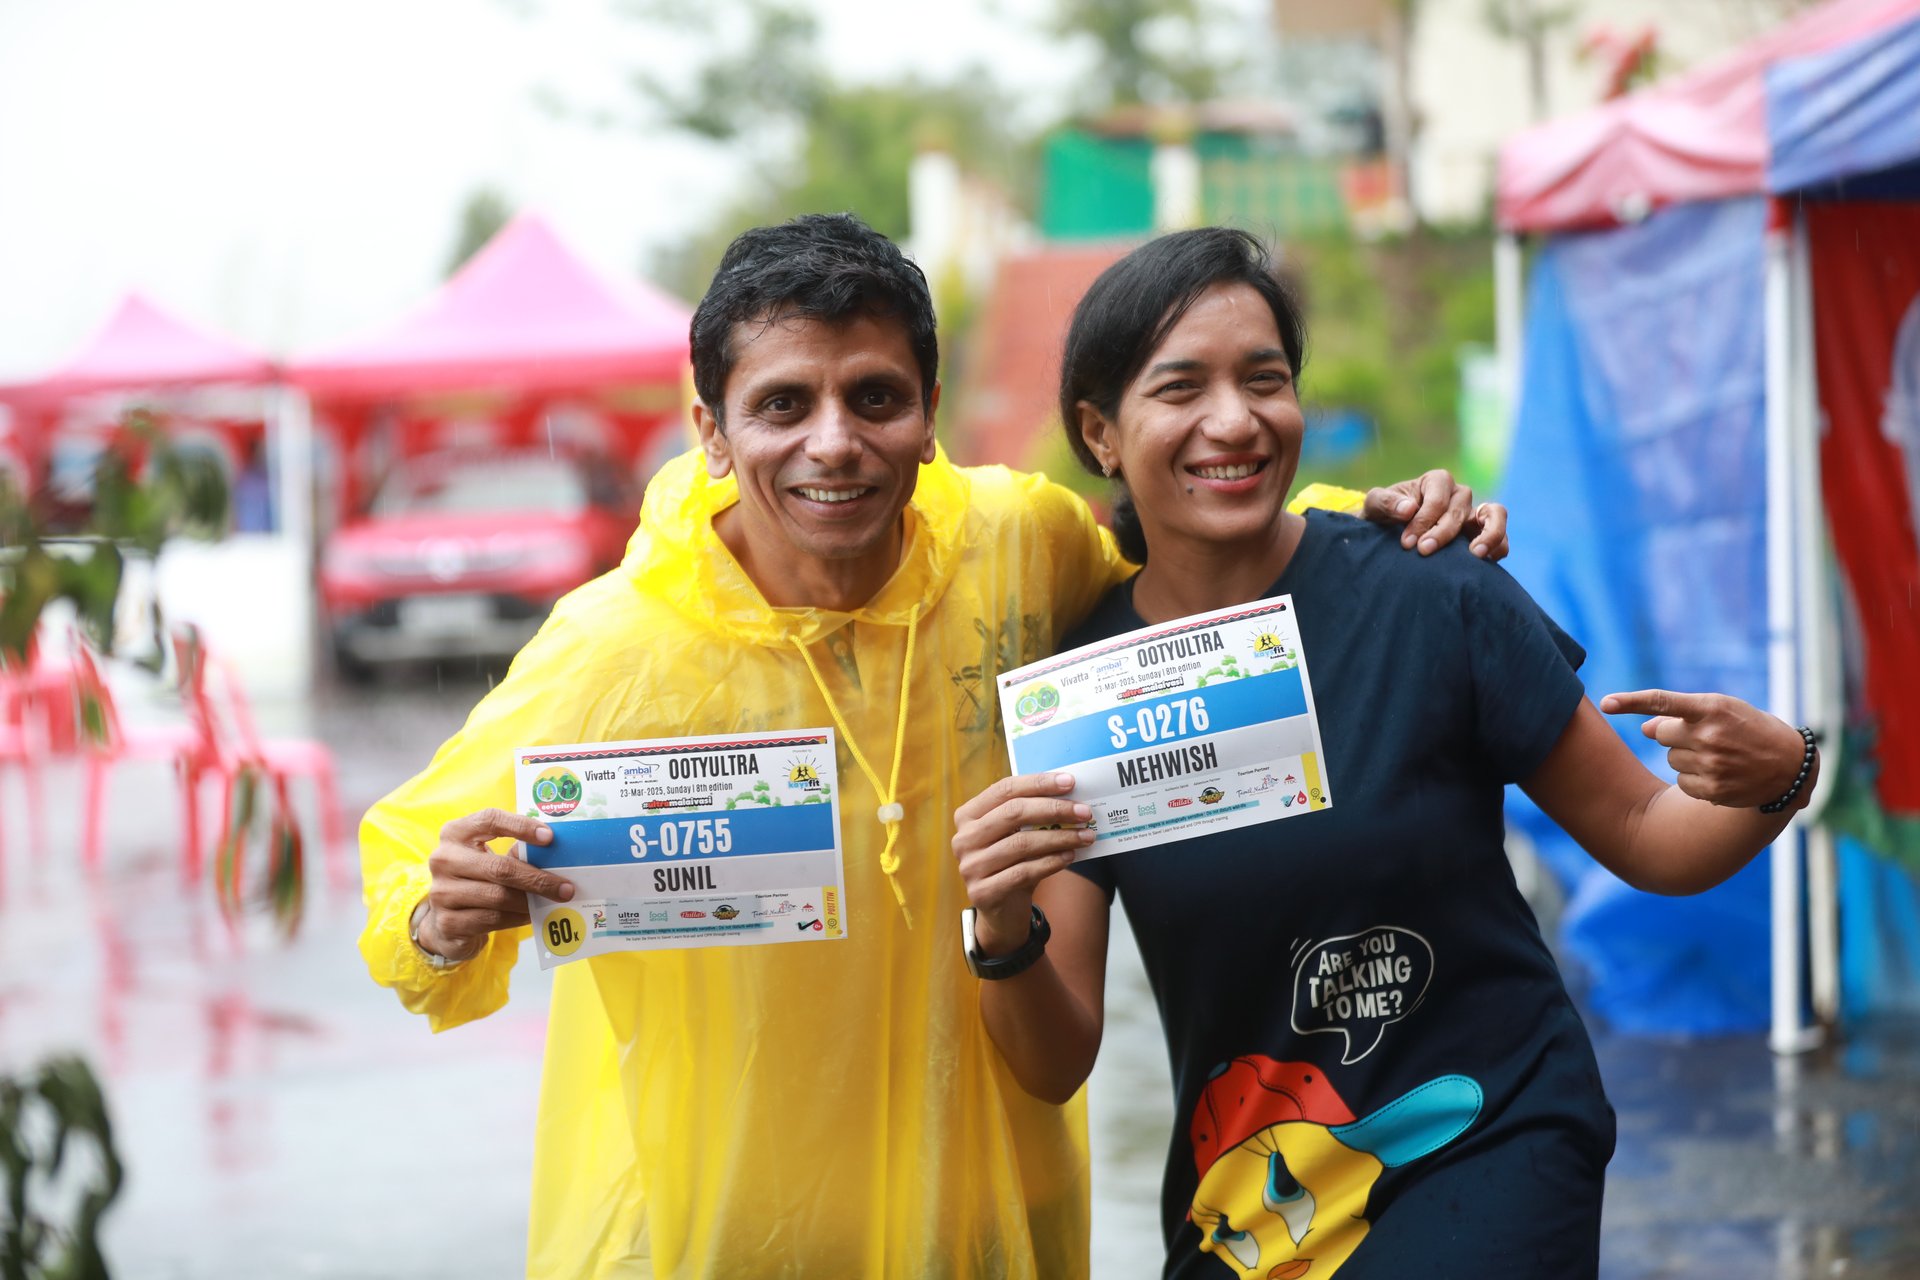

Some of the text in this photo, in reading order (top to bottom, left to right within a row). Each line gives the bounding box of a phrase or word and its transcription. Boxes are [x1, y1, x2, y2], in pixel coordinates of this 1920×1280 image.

[1060, 672, 1088, 687] Vivatta
[1096, 660, 1122, 673] ambal
[1137, 630, 1224, 668] OOTYULTRA
[1138, 670, 1162, 682] Sunday
[1166, 664, 1177, 676] 8th
[1178, 661, 1201, 673] edition
[1108, 696, 1210, 748] S-0276
[585, 753, 759, 782] Vivatta ambal OOTYULTRA
[1116, 742, 1218, 788] MEHWISH
[620, 787, 666, 798] 23-Mar-2025,
[666, 784, 691, 795] Sunday
[696, 782, 708, 792] 8th
[708, 782, 732, 791] edition
[642, 796, 712, 810] #ultramalaivasi
[541, 801, 576, 812] ootyultra
[1108, 808, 1128, 818] ultra
[630, 818, 732, 858] S-0755
[654, 866, 716, 892] SUNIL
[618, 911, 640, 919] ultra
[1318, 933, 1396, 976] ARE YOU
[1309, 955, 1412, 1008] TALKING
[1322, 990, 1402, 1022] TO ME?
